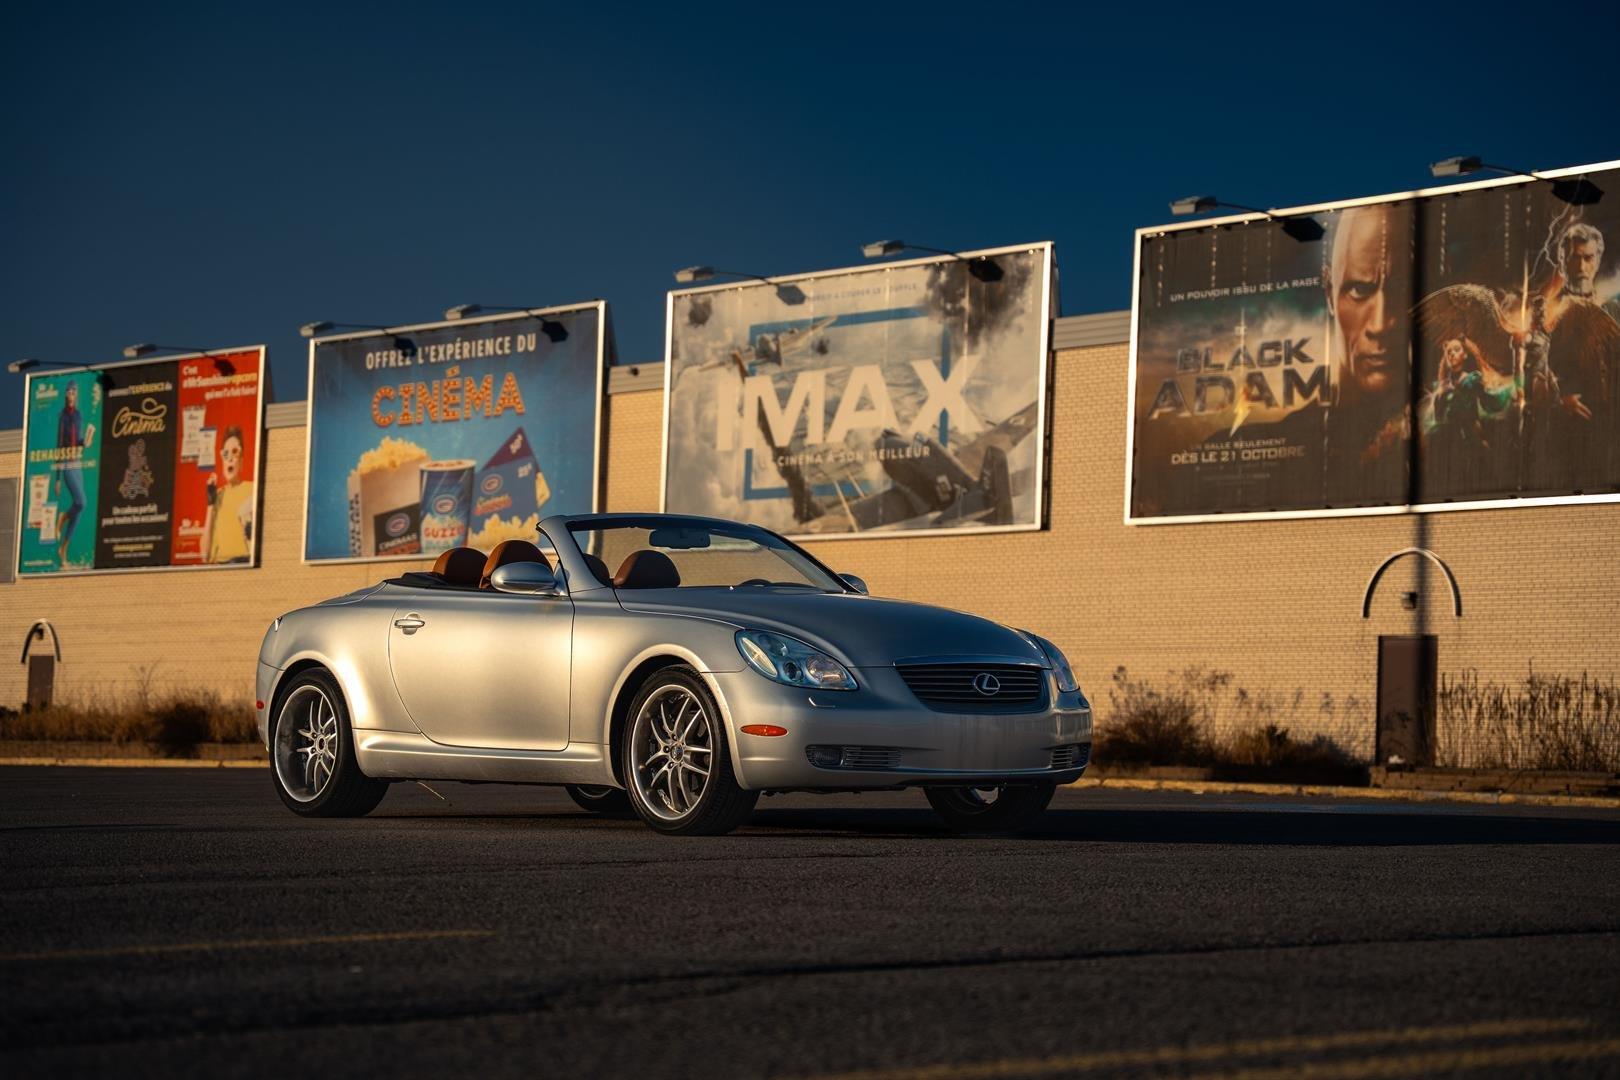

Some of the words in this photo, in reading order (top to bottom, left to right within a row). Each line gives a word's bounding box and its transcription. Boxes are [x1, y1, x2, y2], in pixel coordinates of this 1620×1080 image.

[1170, 294, 1184, 302] UN
[1187, 287, 1230, 300] POUVOIR
[1233, 284, 1257, 296] ISSU
[1260, 281, 1274, 292] DE
[1276, 280, 1289, 290] LA
[365, 348, 412, 370] OFFREZ
[417, 336, 511, 364] L'EXPÉRIENCE
[516, 333, 537, 353] DU
[1177, 336, 1315, 373] BLACK
[371, 365, 526, 428] CINÉMA
[716, 353, 988, 451] IMAX
[1148, 364, 1331, 420] ADAM
[870, 446, 931, 462] MEILLEUR
[1201, 451, 1217, 463] LE
[1220, 450, 1236, 462] 21
[1241, 445, 1305, 461] OCTOBRE
